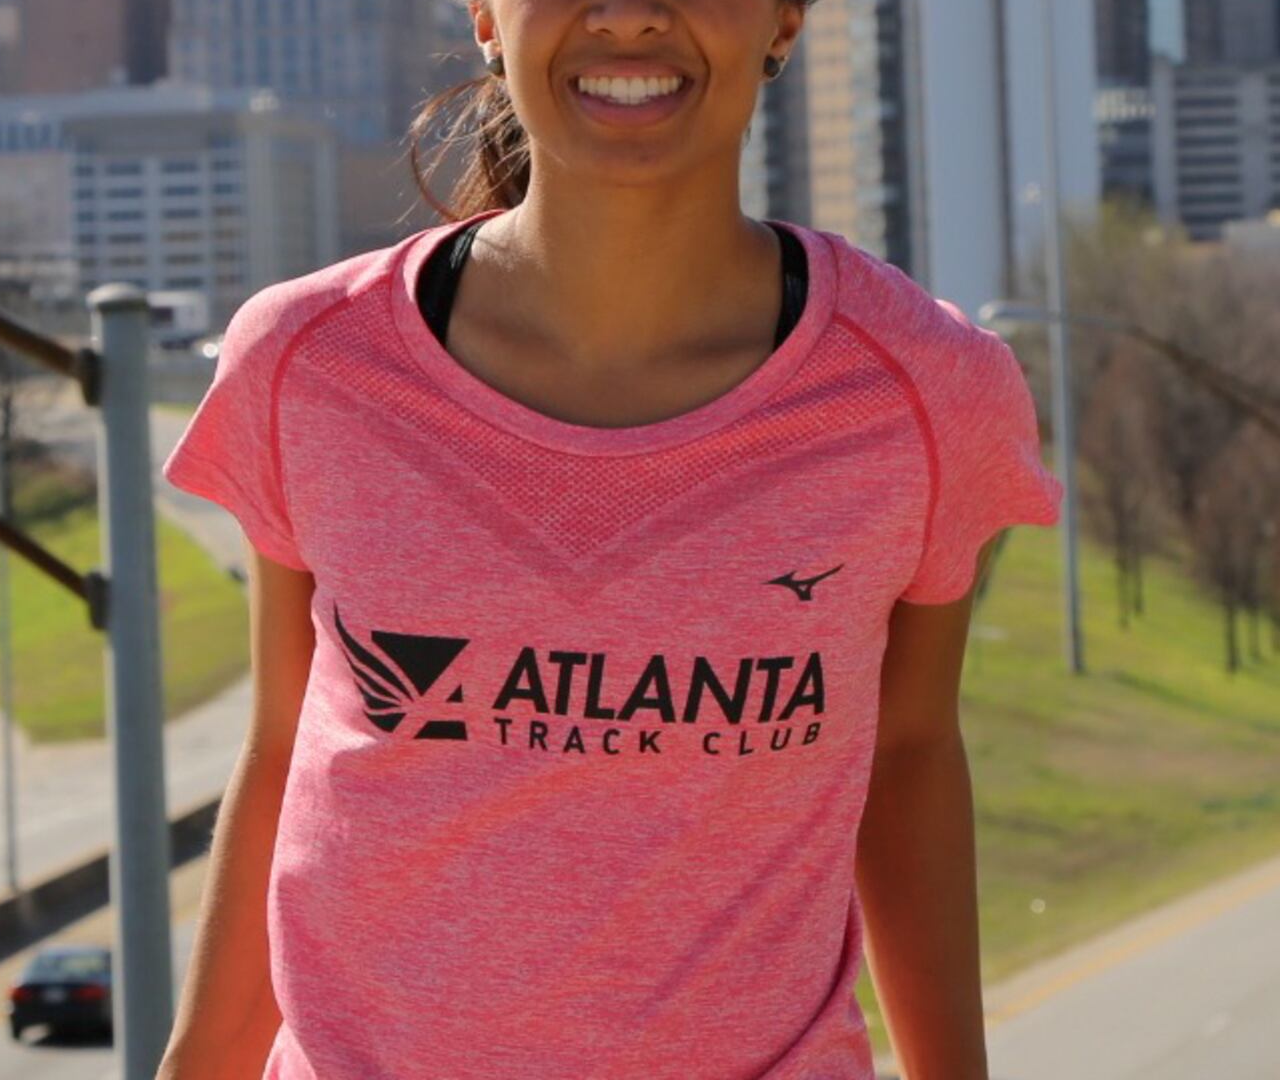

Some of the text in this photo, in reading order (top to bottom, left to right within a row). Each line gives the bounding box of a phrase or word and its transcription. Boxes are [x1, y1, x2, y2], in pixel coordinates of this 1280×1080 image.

[492, 646, 826, 725] ATLANTA
[493, 717, 821, 756] TRACK CLUB
